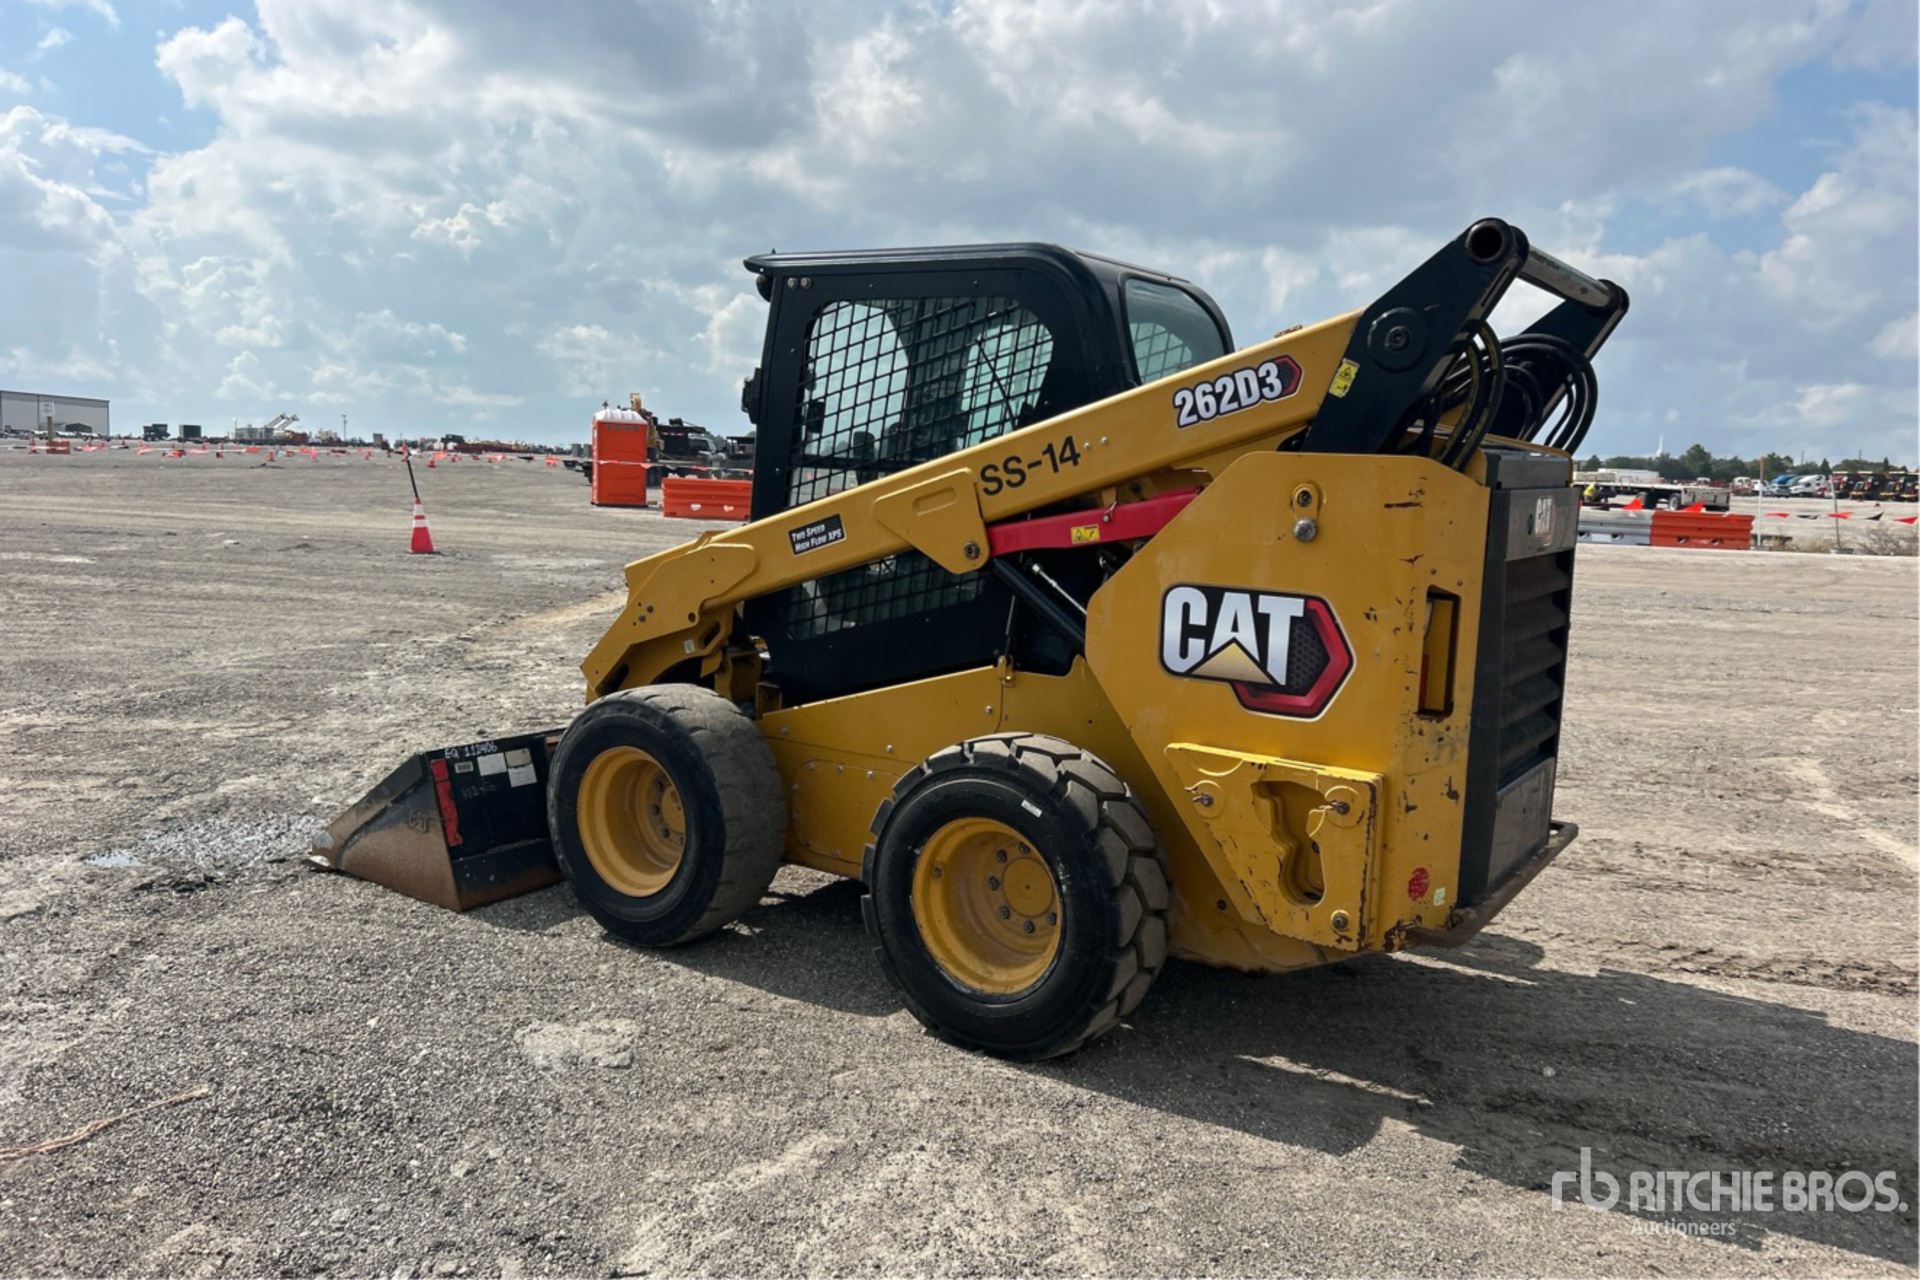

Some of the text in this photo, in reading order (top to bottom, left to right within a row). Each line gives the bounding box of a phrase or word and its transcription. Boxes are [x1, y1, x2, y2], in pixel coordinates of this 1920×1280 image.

[1174, 361, 1283, 427] 262D3
[980, 435, 1081, 496] SS-14
[1163, 585, 1305, 686] CAT
